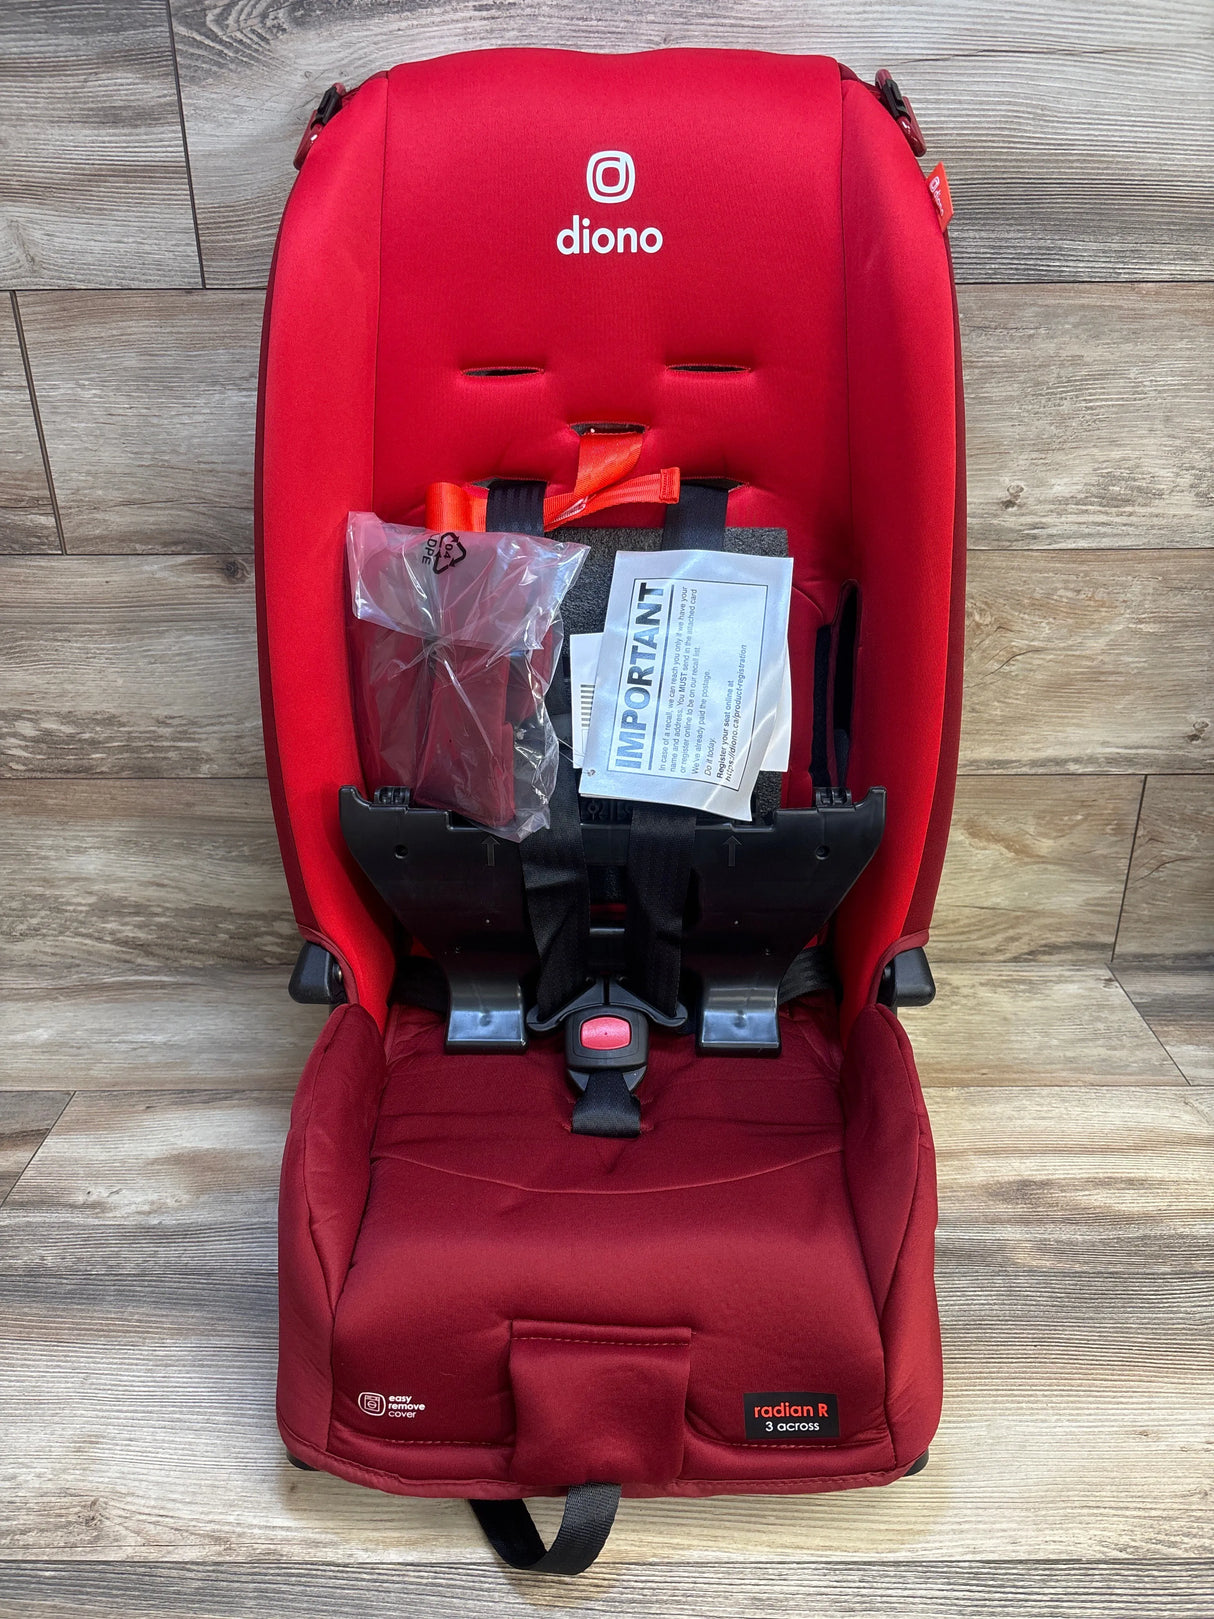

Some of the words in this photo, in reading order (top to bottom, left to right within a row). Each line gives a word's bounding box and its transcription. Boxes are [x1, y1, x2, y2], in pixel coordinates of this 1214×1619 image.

[557, 214, 664, 254] diono
[421, 535, 438, 565] DPE
[681, 586, 689, 602] your
[689, 589, 698, 604] card
[678, 603, 686, 620] have
[677, 621, 684, 631] we
[673, 638, 683, 652] only
[684, 636, 692, 646] the
[672, 653, 681, 665] you
[681, 655, 690, 671] send
[690, 658, 699, 675] recall
[615, 582, 665, 769] IMPORTANT
[669, 666, 678, 685] reach
[678, 672, 687, 693] MUST
[701, 669, 712, 697] postage.
[677, 694, 685, 706] You
[689, 689, 695, 698] on
[724, 689, 733, 710] online
[668, 699, 674, 709] we
[687, 698, 694, 708] be
[664, 710, 674, 730] recall,
[697, 710, 707, 725] paid
[725, 644, 748, 782] https://diono.ca/product-registration
[683, 716, 693, 738] online
[694, 726, 705, 752] already
[721, 728, 731, 745] your
[660, 747, 668, 763] case
[680, 739, 691, 765] register
[706, 737, 717, 758] today.
[670, 753, 678, 772] name
[679, 766, 686, 774] or
[691, 753, 701, 774] We've
[704, 765, 712, 776] Do
[716, 746, 729, 779] Register
[388, 1395, 412, 1403] easy
[754, 1402, 813, 1418] radian
[818, 1403, 828, 1417] R
[765, 1421, 774, 1432] 3
[777, 1422, 820, 1432] across
